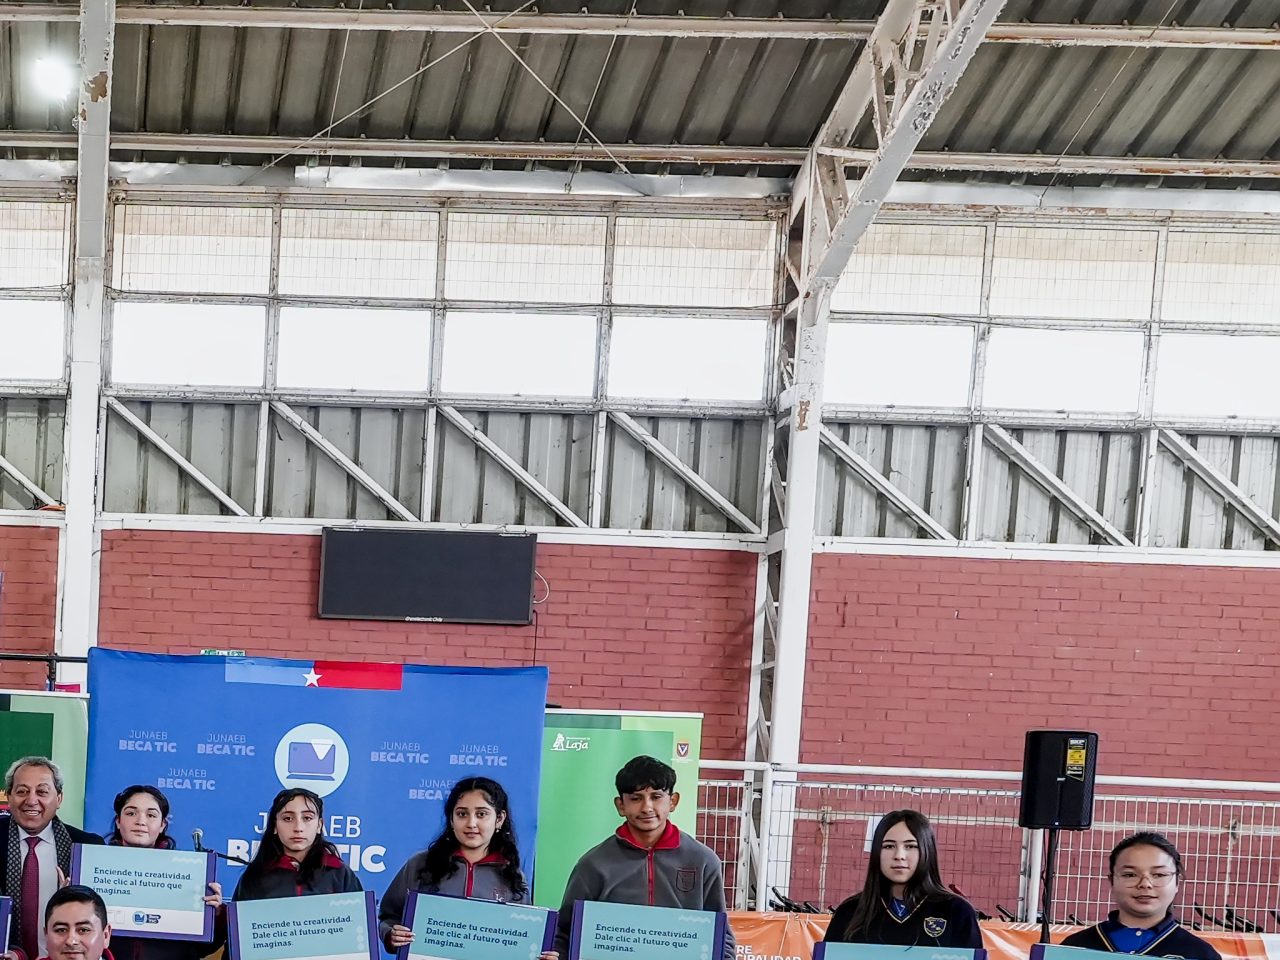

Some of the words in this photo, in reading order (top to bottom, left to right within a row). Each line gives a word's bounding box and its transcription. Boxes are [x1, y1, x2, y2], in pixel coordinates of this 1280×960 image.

[129, 730, 168, 740] JUNAEB
[208, 734, 246, 743] JUNAEB
[119, 740, 152, 751] BECA
[155, 742, 176, 752] TIC
[197, 744, 231, 755] BECA
[233, 745, 255, 756] TIC
[381, 741, 420, 751] JUNAEB
[460, 745, 499, 754] JUNAEB
[566, 740, 588, 751] Laja
[371, 752, 405, 763] BECA
[407, 753, 429, 764] TIC
[450, 755, 483, 765] BECA
[485, 756, 507, 766] TIC
[168, 768, 206, 778] JUNAEB
[158, 778, 191, 789] BECA
[193, 780, 216, 790] TIC
[420, 779, 454, 788] JUNAE
[409, 789, 443, 800] BECA
[332, 844, 386, 872] TIC
